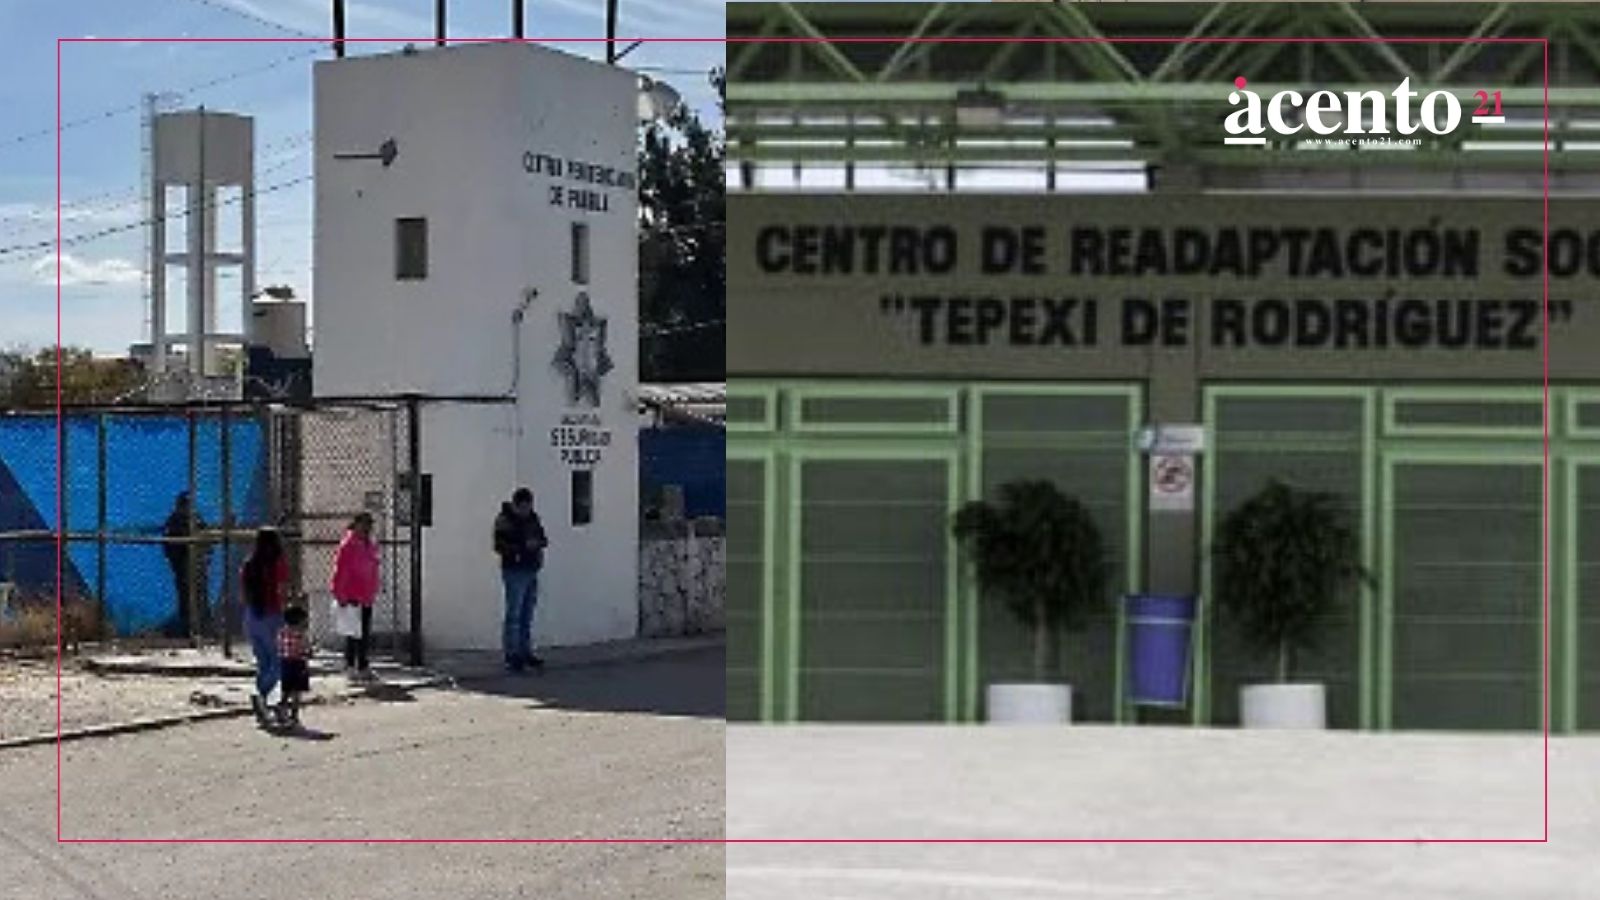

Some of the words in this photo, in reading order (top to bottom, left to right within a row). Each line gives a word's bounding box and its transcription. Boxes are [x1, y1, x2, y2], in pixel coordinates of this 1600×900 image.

[757, 226, 958, 274] CENTRO
[982, 227, 1047, 276] DE
[1071, 216, 1480, 278] READAPTACIÓN
[1122, 298, 1188, 347] DE
